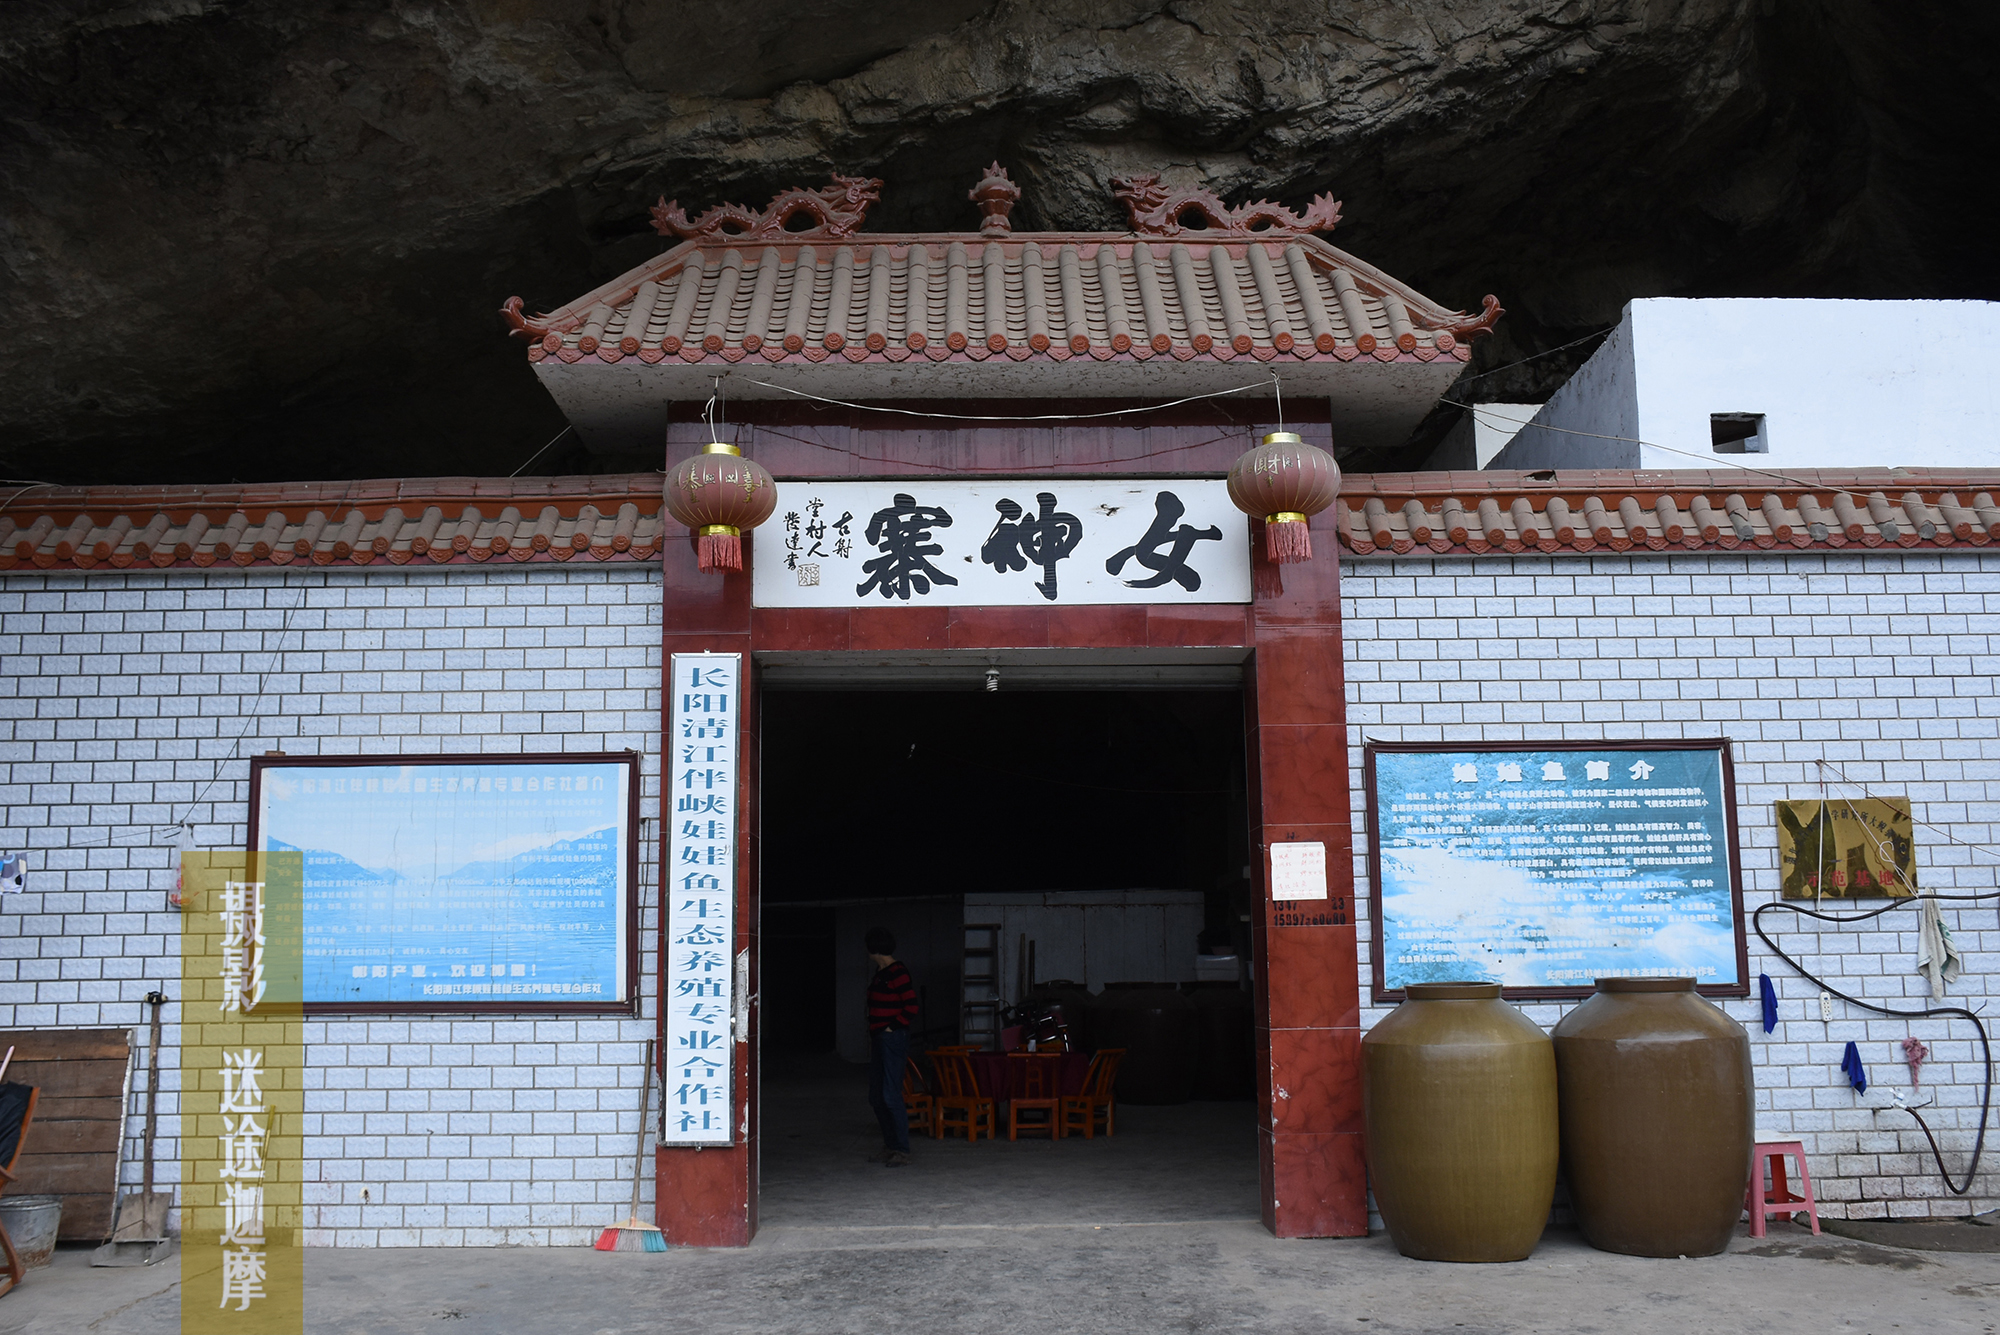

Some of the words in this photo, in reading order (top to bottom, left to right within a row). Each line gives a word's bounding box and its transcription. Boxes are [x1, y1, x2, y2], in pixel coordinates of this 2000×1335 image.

[671, 667, 730, 1132] 长阳清江伴峡娃娃鱼生态养殖专业合作社
[1806, 869, 1895, 888] 示范基地
